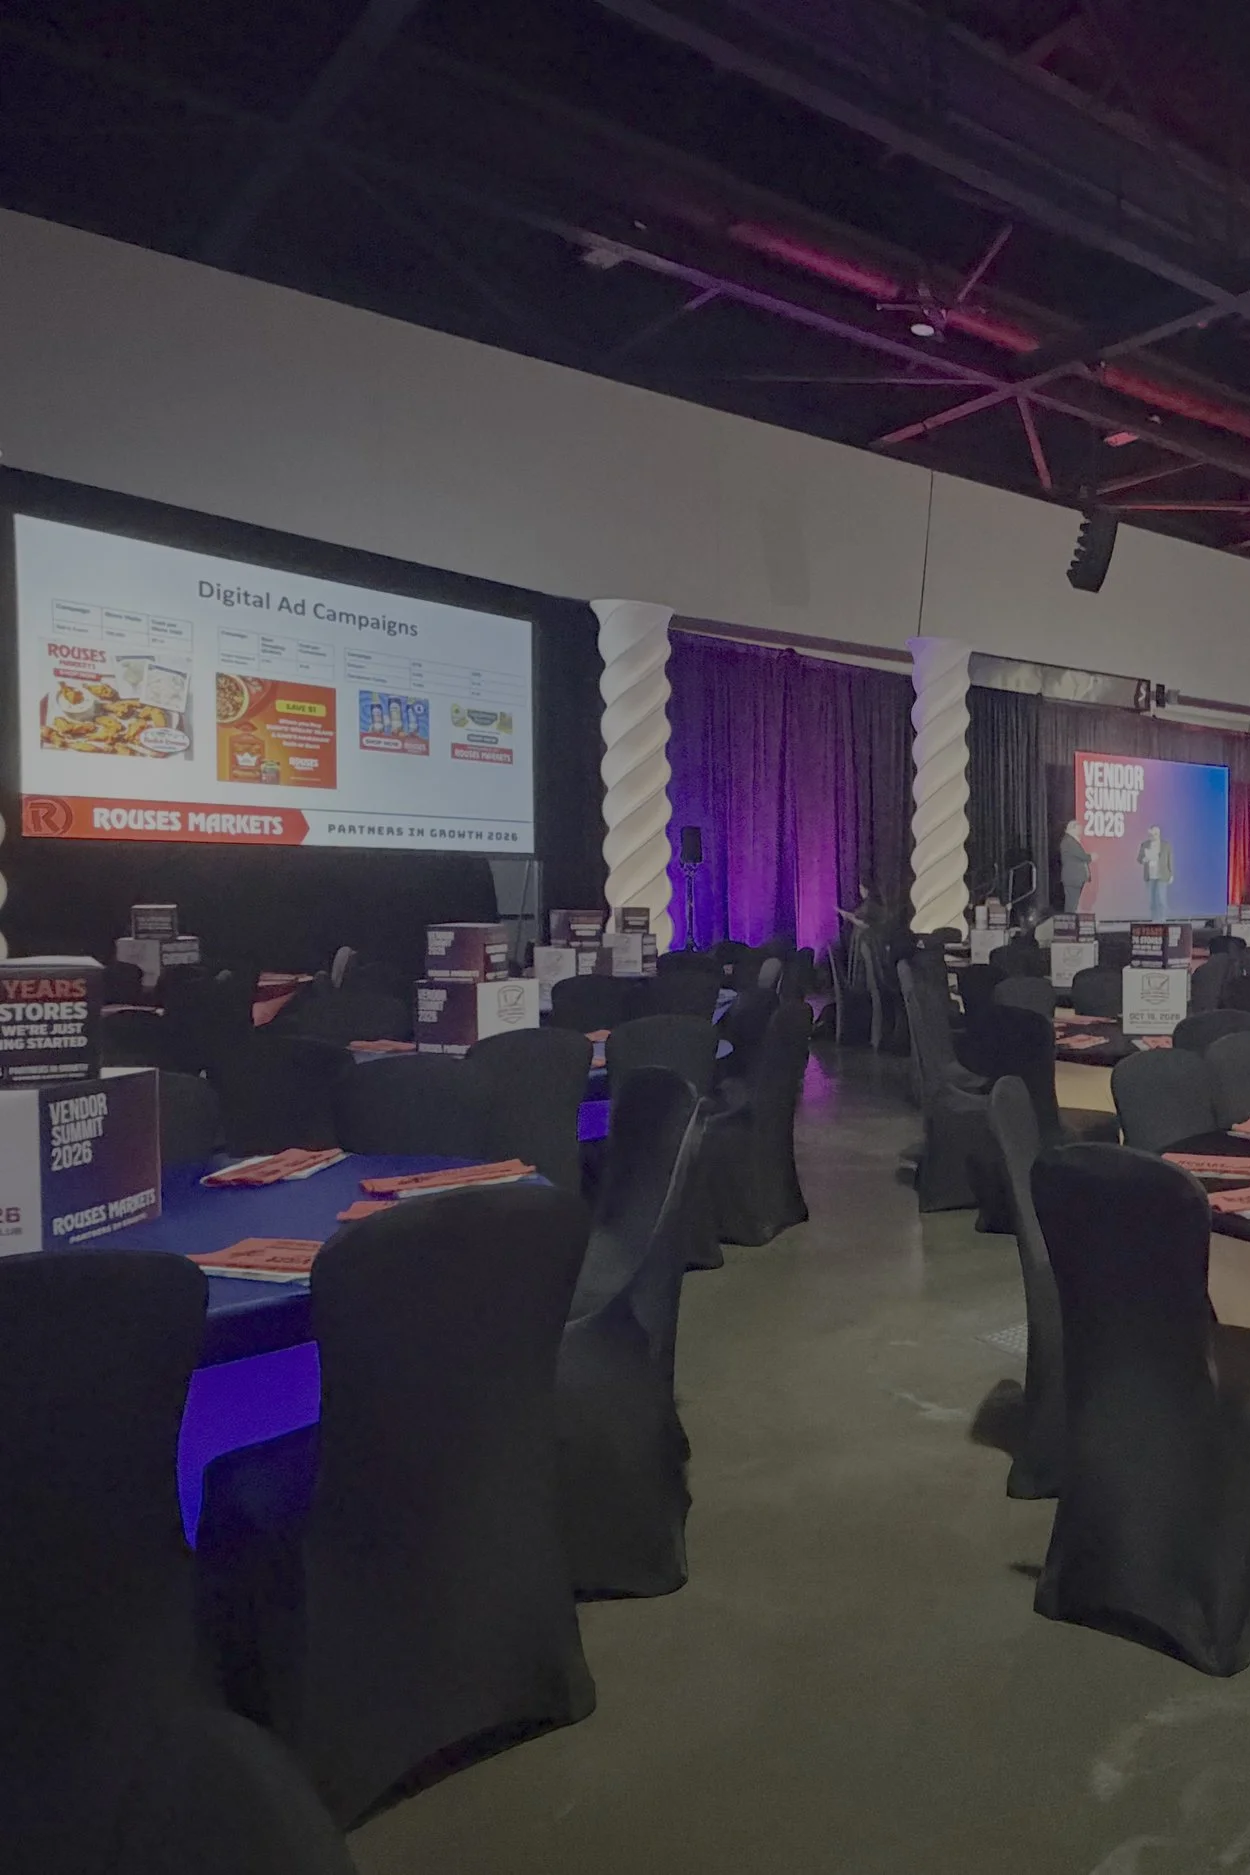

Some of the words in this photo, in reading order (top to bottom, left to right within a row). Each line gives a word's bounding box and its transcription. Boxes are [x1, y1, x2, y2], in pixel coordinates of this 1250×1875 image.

[197, 579, 271, 609] Digital
[277, 596, 306, 616] Ad
[313, 603, 419, 637] Campaigns
[47, 643, 107, 663] ROUSES
[1083, 760, 1145, 791] VENDOR
[1085, 786, 1140, 812] SUMMIT
[92, 807, 181, 832] ROUSES
[187, 812, 284, 836] MARKETS
[327, 823, 404, 838] PARTNERS
[408, 826, 425, 838] IN
[428, 828, 484, 841] GROWTH
[486, 831, 520, 843] 2026
[1083, 809, 1126, 839] 2026
[1, 977, 88, 1001] YEARS
[0, 1001, 89, 1023] STORES
[1, 1024, 48, 1037] WE'RE
[50, 1023, 85, 1035] JUST
[26, 1035, 89, 1049] STARTED
[48, 1092, 109, 1125] VENDOR
[51, 1116, 105, 1147] SUMMIT
[51, 1141, 94, 1172] 2026
[52, 1204, 107, 1236] ROUSES
[108, 1188, 156, 1219] MARKETS
